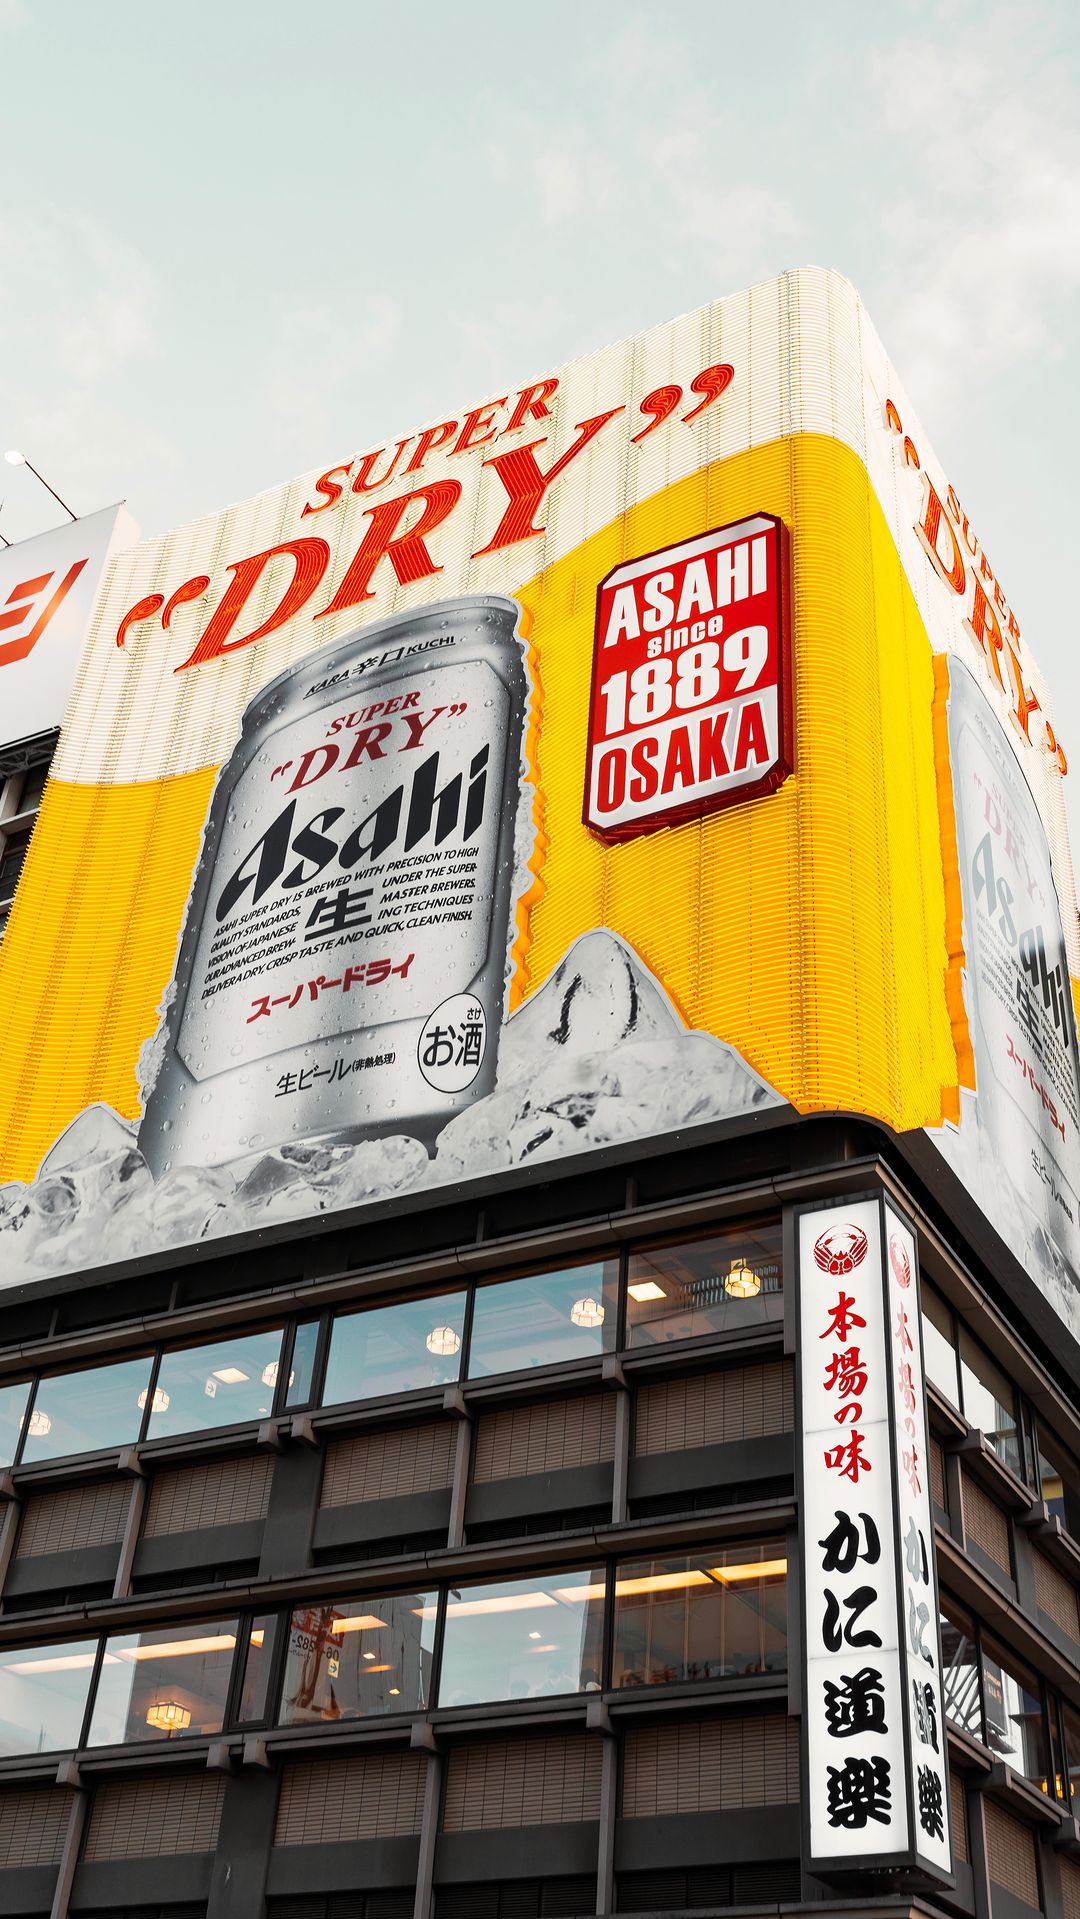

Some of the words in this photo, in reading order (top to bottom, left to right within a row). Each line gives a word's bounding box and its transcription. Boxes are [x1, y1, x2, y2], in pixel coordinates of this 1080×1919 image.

[300, 378, 560, 518] SUPER
[603, 536, 768, 650] ASAHI
[945, 484, 1021, 654] SUPER
[304, 669, 350, 698] KARA
[352, 646, 405, 677] 辛口
[406, 635, 455, 655] KUCHI
[600, 625, 769, 737] 1889
[646, 614, 724, 660] since
[326, 691, 421, 738] SUPER
[598, 698, 770, 814] OSAKA
[216, 743, 490, 923] Asahi
[207, 948, 237, 970] VISION
[235, 943, 248, 957] OF
[245, 921, 299, 952] JAPANESE
[380, 885, 430, 905] MASTER
[210, 929, 245, 954] QUALITY
[243, 906, 302, 938] STANDARDS,
[382, 871, 423, 889] UNDER
[424, 866, 447, 879] THE
[213, 917, 239, 939] ASAHI
[238, 904, 269, 927] SUPER
[269, 894, 293, 912] DRY
[292, 890, 305, 903] IS
[305, 874, 352, 898] BREWED
[354, 864, 386, 881] WITH
[385, 851, 442, 873] PRECISION
[443, 849, 457, 860] TO
[456, 847, 480, 860] HIGH
[303, 887, 375, 943] 生
[200, 977, 236, 1002] DELIVER
[233, 972, 242, 985] A
[242, 963, 266, 981] DRY,
[265, 950, 299, 972] CRISP
[298, 938, 336, 960] TASTE
[334, 931, 364, 949] AND
[364, 922, 405, 940] QUICK,
[405, 914, 442, 930] CLEAN
[440, 910, 474, 924] FINISH.
[204, 968, 221, 985] OUR
[218, 947, 267, 976] ADVANCED
[377, 905, 403, 921] ING
[403, 894, 475, 915] TECHNIQUES
[972, 832, 1069, 1048] Asahi
[246, 953, 415, 1024] スーパードライ
[466, 1007, 483, 1020] さけ
[1016, 978, 1043, 1051] 生
[422, 1022, 484, 1067] お酒
[1005, 1033, 1066, 1144] スーパードライ
[818, 1290, 872, 1484] 本場の味
[895, 1301, 922, 1499] 本場の味
